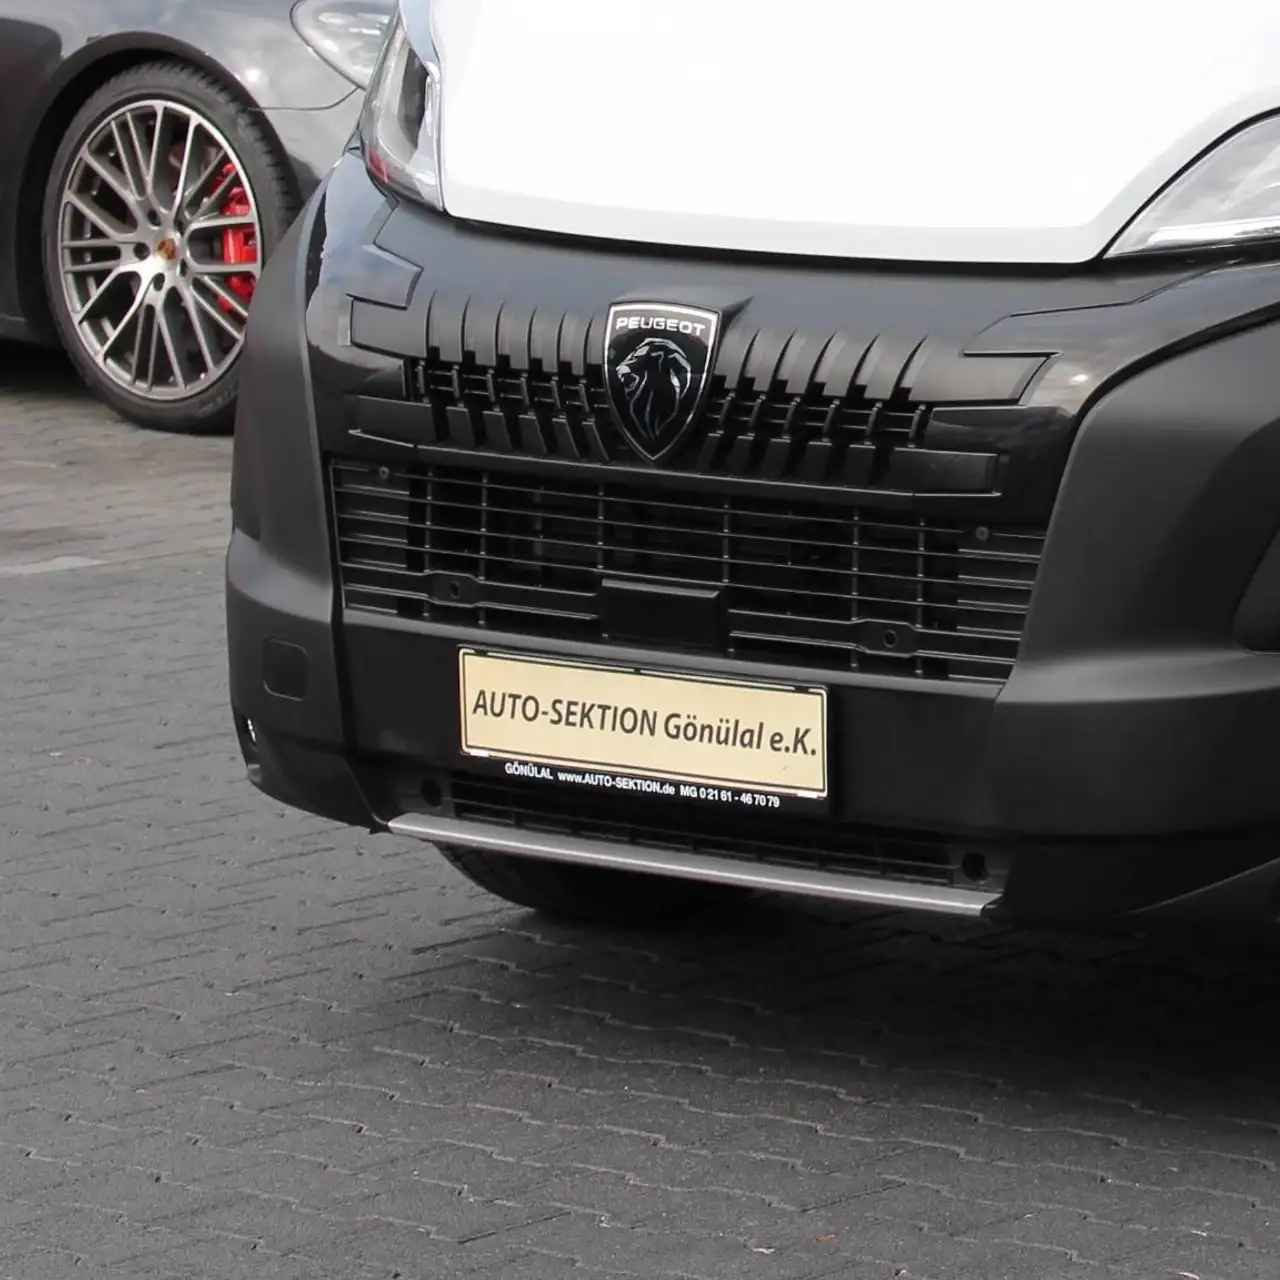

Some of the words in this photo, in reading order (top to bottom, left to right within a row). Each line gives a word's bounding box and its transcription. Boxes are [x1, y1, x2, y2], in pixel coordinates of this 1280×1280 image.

[615, 316, 706, 337] PEUGEOT
[472, 689, 657, 737] AUTO-SEKTION
[663, 712, 765, 750] Gönülal
[769, 726, 817, 757] e.K.
[504, 760, 554, 781] GÖNÜLAL
[557, 771, 676, 796] www.AUTO-SEKTION.de
[679, 784, 697, 798] MG
